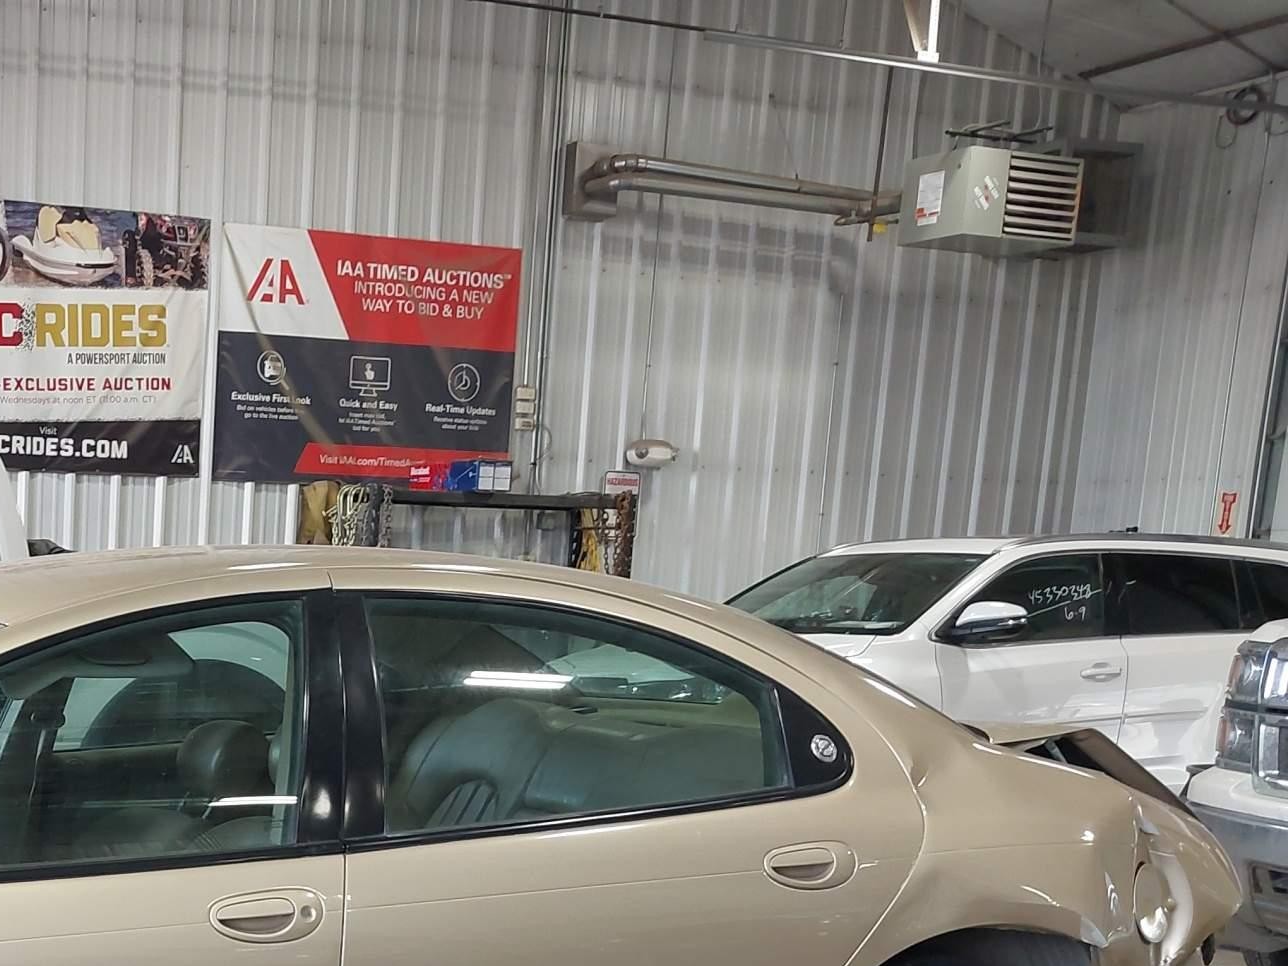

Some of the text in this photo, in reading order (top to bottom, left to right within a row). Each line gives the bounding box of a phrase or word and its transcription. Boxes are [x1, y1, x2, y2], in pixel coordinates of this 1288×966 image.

[337, 259, 364, 277] IAA
[367, 263, 419, 282] TIMED
[354, 280, 494, 304] INTRODUCING A NEW
[362, 297, 484, 320] WAY TO BID & BUY
[67, 353, 166, 365] A POWERSPORT AUCTION
[102, 377, 172, 391] AUCTION
[0, 395, 49, 405] Wednesdays
[50, 396, 60, 404] at
[86, 396, 97, 404] ET
[231, 391, 271, 402] Exclusive
[339, 398, 398, 412] Quick and Easy
[425, 403, 496, 416] Real-Time Updates
[39, 426, 58, 435] Visit
[319, 454, 338, 464] Visit
